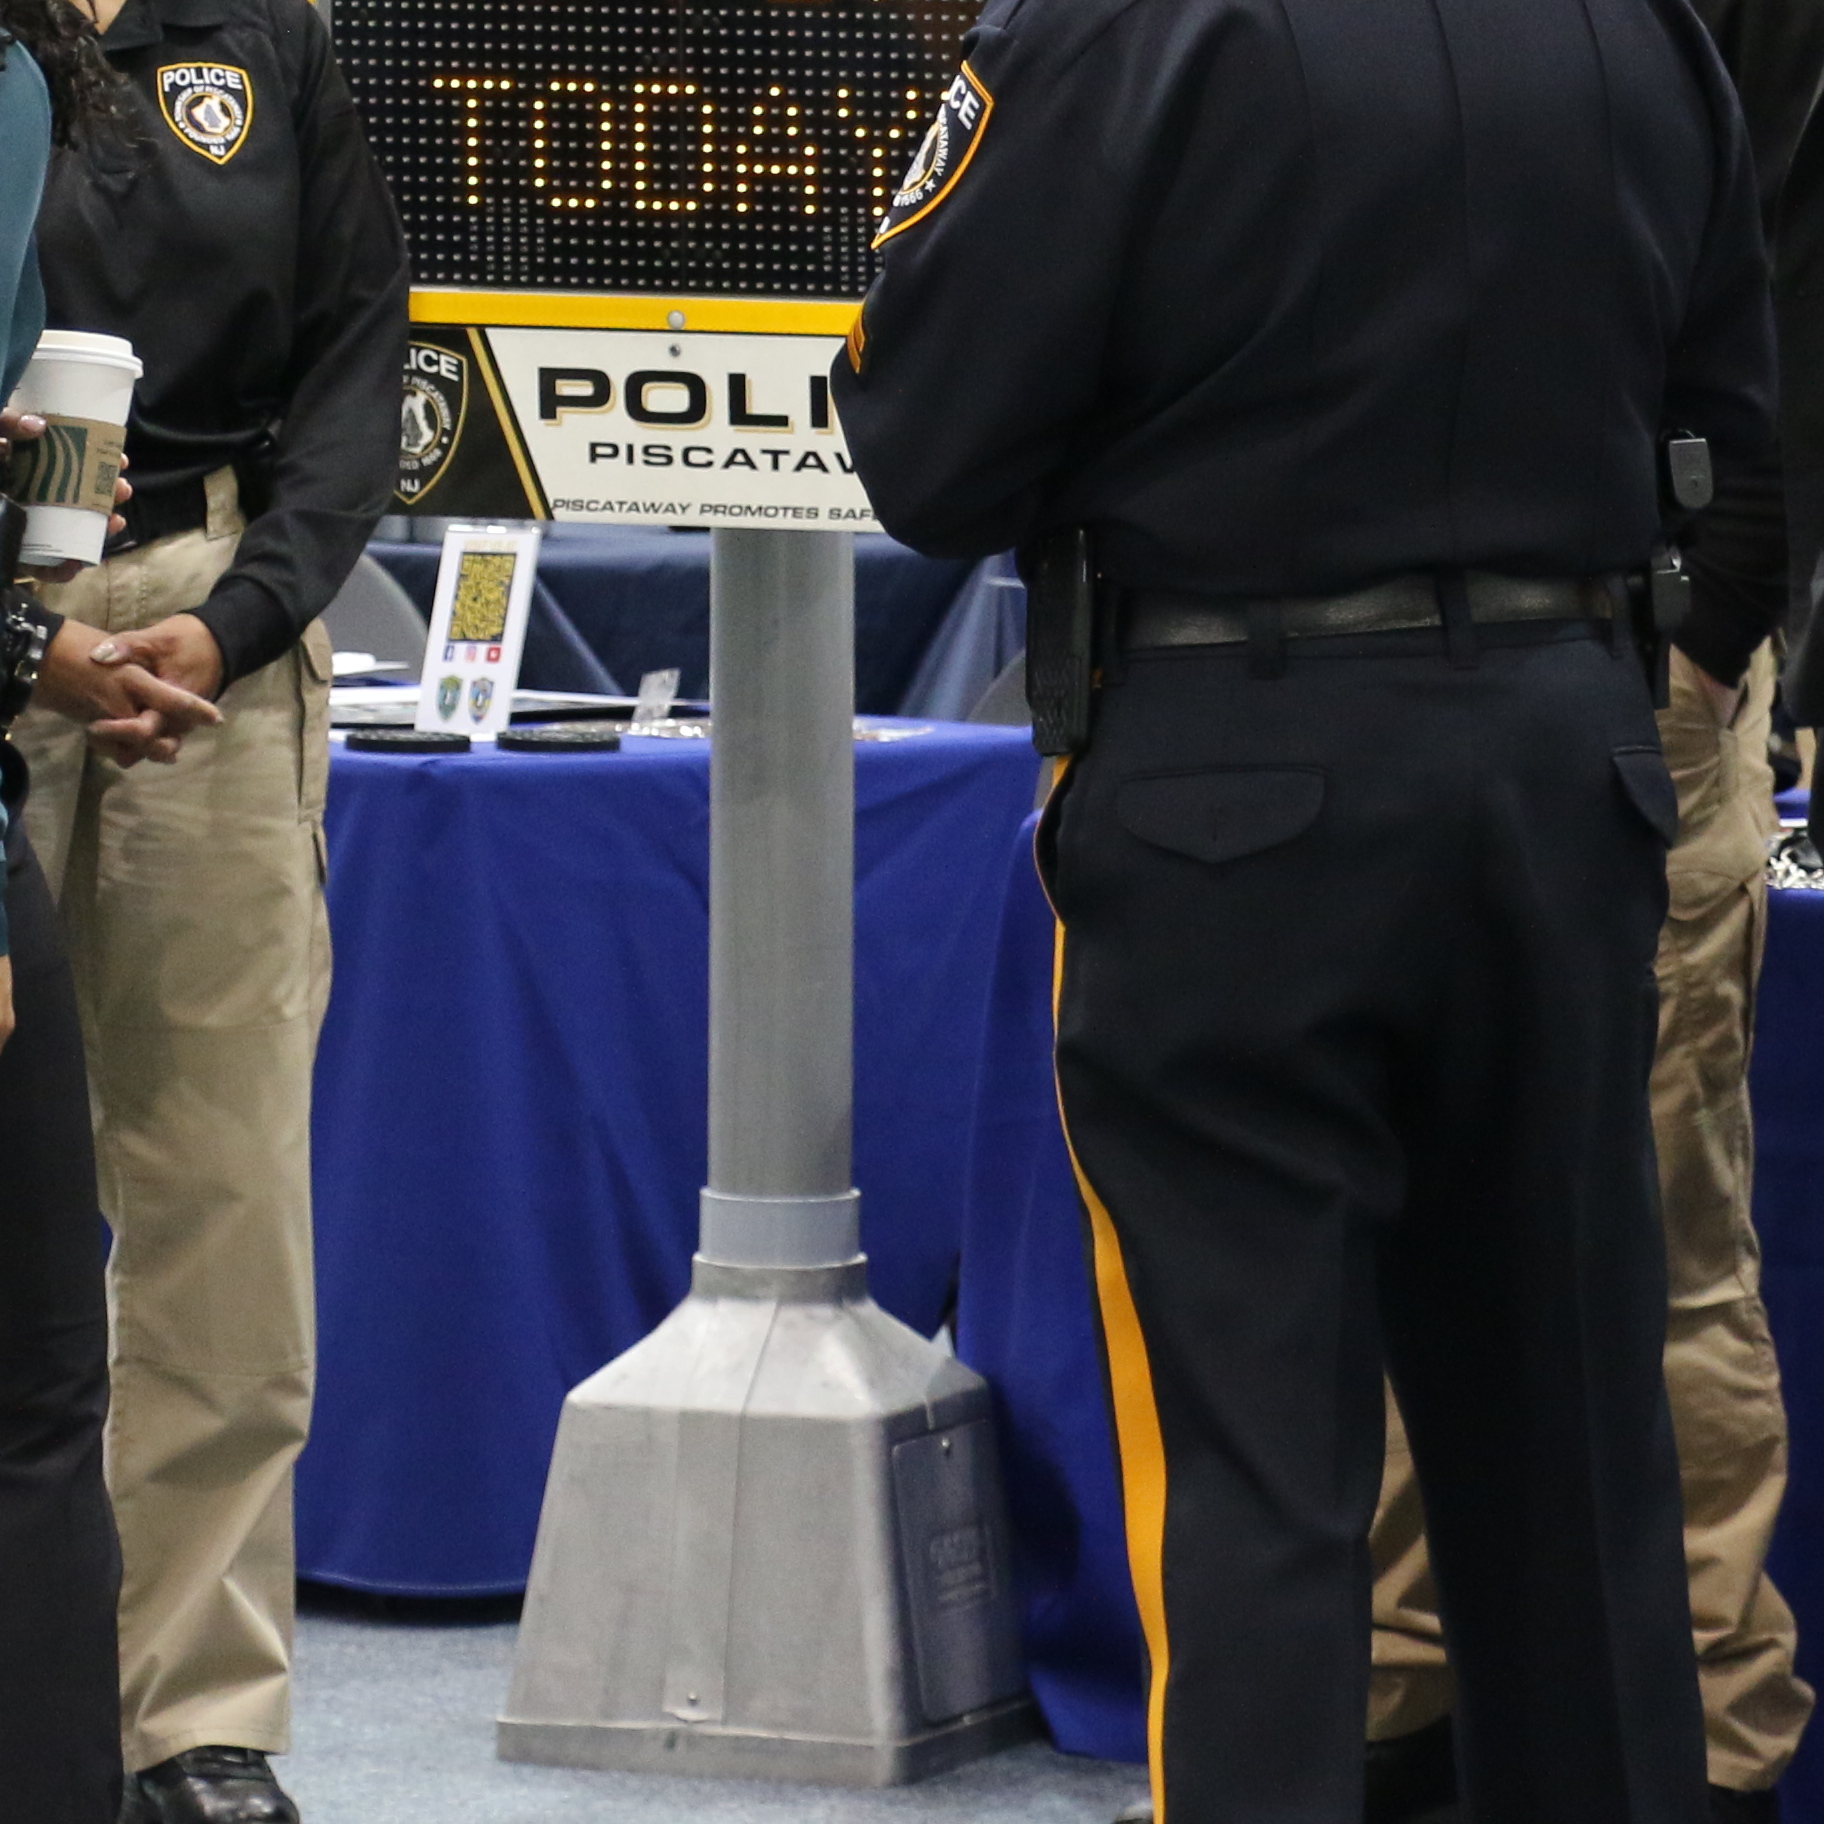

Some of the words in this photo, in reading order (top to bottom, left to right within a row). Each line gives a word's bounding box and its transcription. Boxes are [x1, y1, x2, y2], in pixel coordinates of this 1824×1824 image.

[162, 67, 244, 93] POLICE
[430, 76, 920, 218] TODAY
[403, 348, 460, 382] ICE
[538, 366, 837, 435] POLI
[588, 442, 855, 475] PISCATA
[552, 498, 692, 517] PISCATAWAY
[699, 503, 819, 520] PROMOTES
